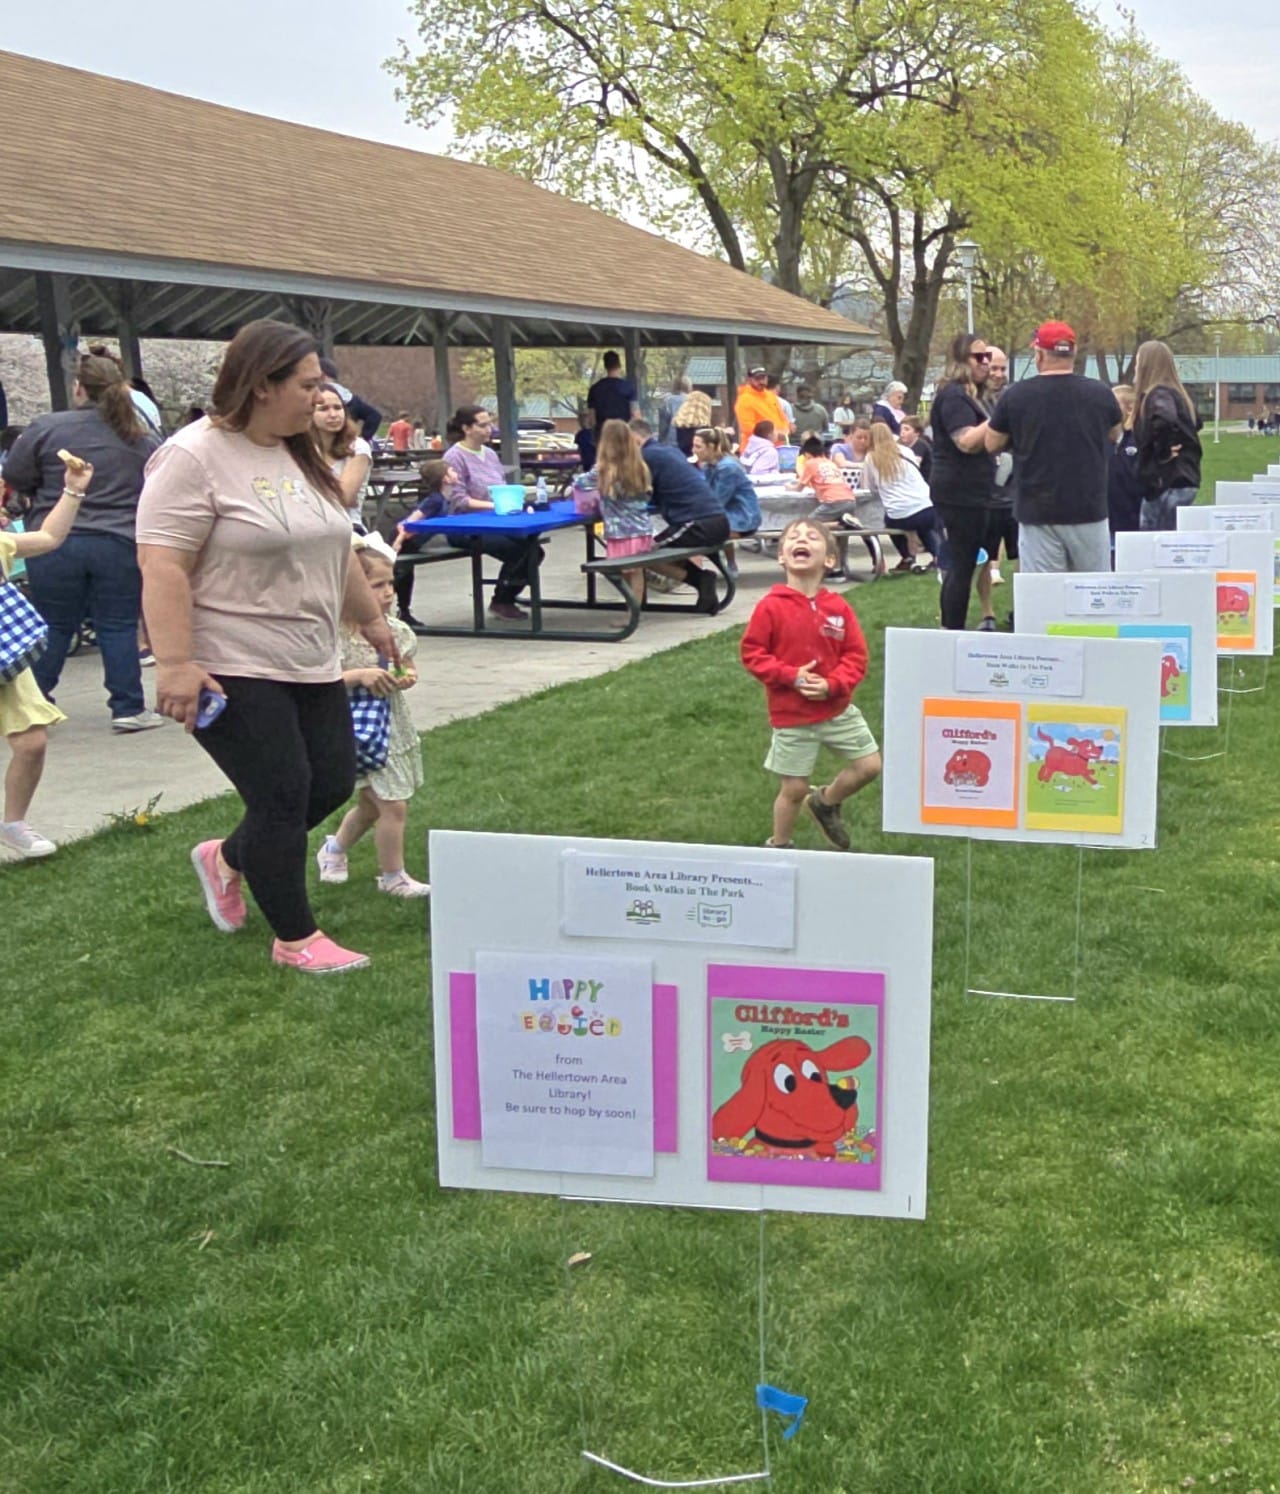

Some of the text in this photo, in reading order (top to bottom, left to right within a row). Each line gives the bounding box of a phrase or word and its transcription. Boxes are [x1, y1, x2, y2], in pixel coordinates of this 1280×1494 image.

[585, 866, 641, 879] Hellertown
[643, 870, 667, 880] Area
[670, 872, 708, 885] Library
[625, 882, 745, 899] Book Walks in The Park
[528, 978, 604, 1003] HAPPY
[735, 1004, 850, 1028] Clifford's
[761, 1025, 827, 1036] Happy Easter
[555, 1053, 583, 1065] from
[512, 1069, 628, 1085] The Hellertown Area
[548, 1088, 592, 1102] Library!
[505, 1102, 636, 1119] Be sure to hop by soon!
